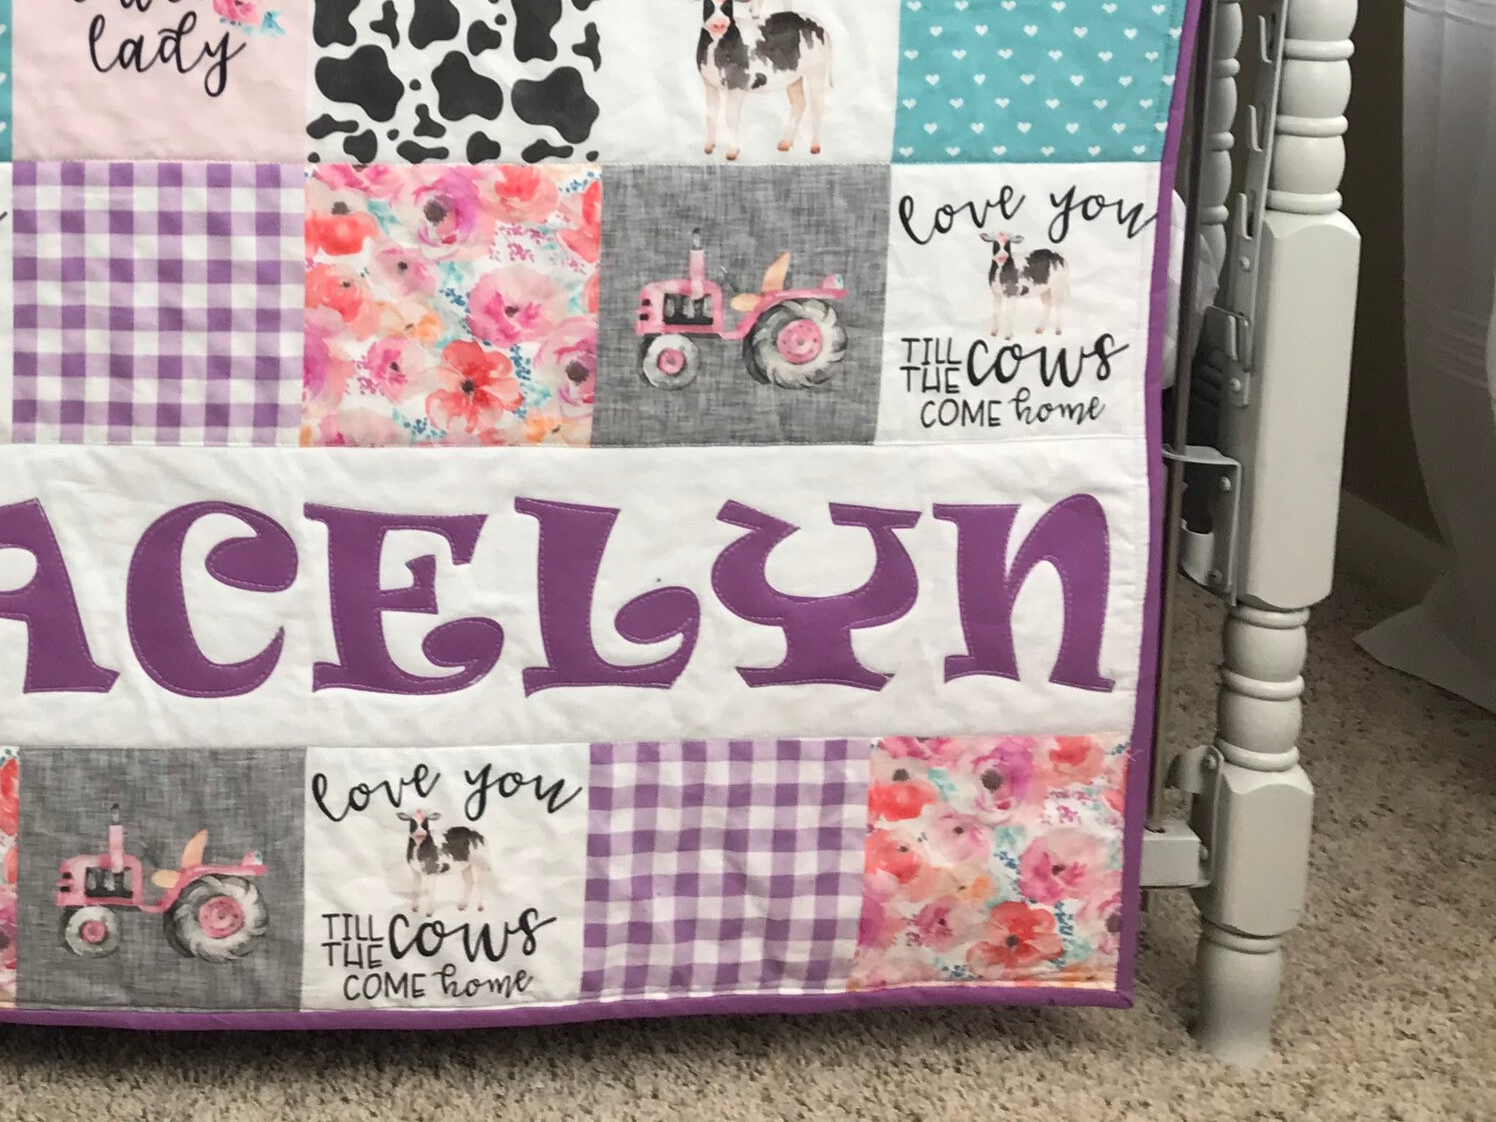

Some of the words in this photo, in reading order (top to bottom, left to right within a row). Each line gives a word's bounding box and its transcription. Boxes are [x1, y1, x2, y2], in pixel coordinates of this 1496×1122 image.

[88, 10, 246, 97] lady
[899, 185, 1026, 245] love
[1048, 185, 1157, 243] you
[901, 338, 962, 365] TILL
[900, 366, 960, 393] THE
[920, 399, 1001, 428] COME
[1008, 387, 1106, 425] home
[312, 764, 441, 822] love
[464, 763, 583, 821] you
[322, 914, 384, 941] TILL
[321, 942, 383, 969] THE
[343, 972, 426, 1000] COME
[432, 963, 534, 998] home
